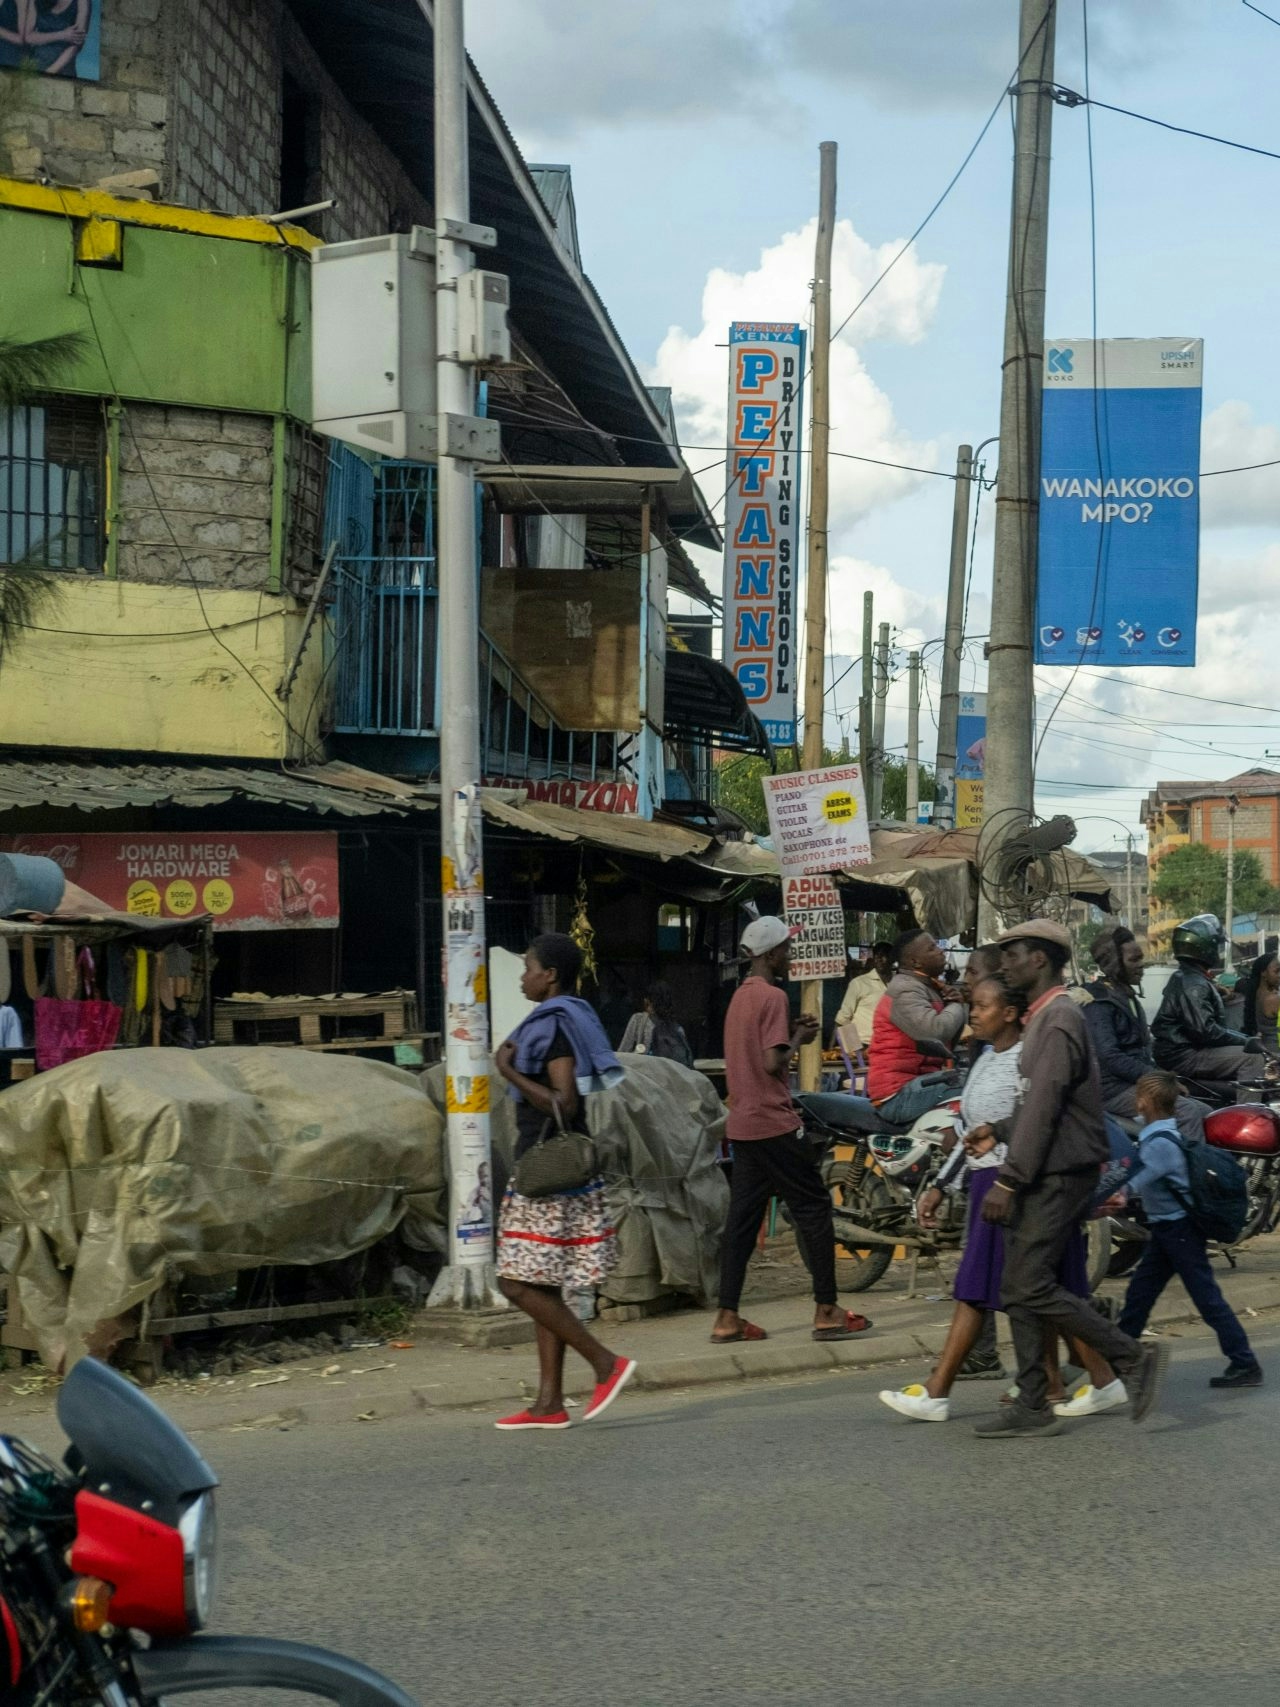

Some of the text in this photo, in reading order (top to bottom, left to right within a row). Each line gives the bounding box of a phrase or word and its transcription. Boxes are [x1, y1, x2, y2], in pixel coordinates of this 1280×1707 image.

[734, 332, 794, 341] KENYA
[1160, 351, 1195, 361] UPISHI
[1160, 361, 1195, 369] SMART
[1042, 477, 1194, 499] WANAKOKO
[1081, 502, 1153, 523] MPO?
[732, 348, 779, 705] PETANNS
[776, 356, 794, 694] DRIVING SCHOOL
[769, 767, 859, 791] MUSIC CLASSES
[775, 791, 802, 803] PIANO
[777, 803, 808, 815] GUITAR
[827, 809, 852, 819] EXAMS
[779, 815, 808, 828] VIOLIN
[781, 827, 813, 840] VOCALS
[117, 844, 240, 861] JOMARI MEGA
[783, 838, 833, 853] SAXOPHONE
[127, 861, 231, 878] HARDWARE
[787, 892, 840, 908] SCHOOL
[790, 926, 844, 943] ANGUAGES
[791, 943, 843, 960] BEGINNERS
